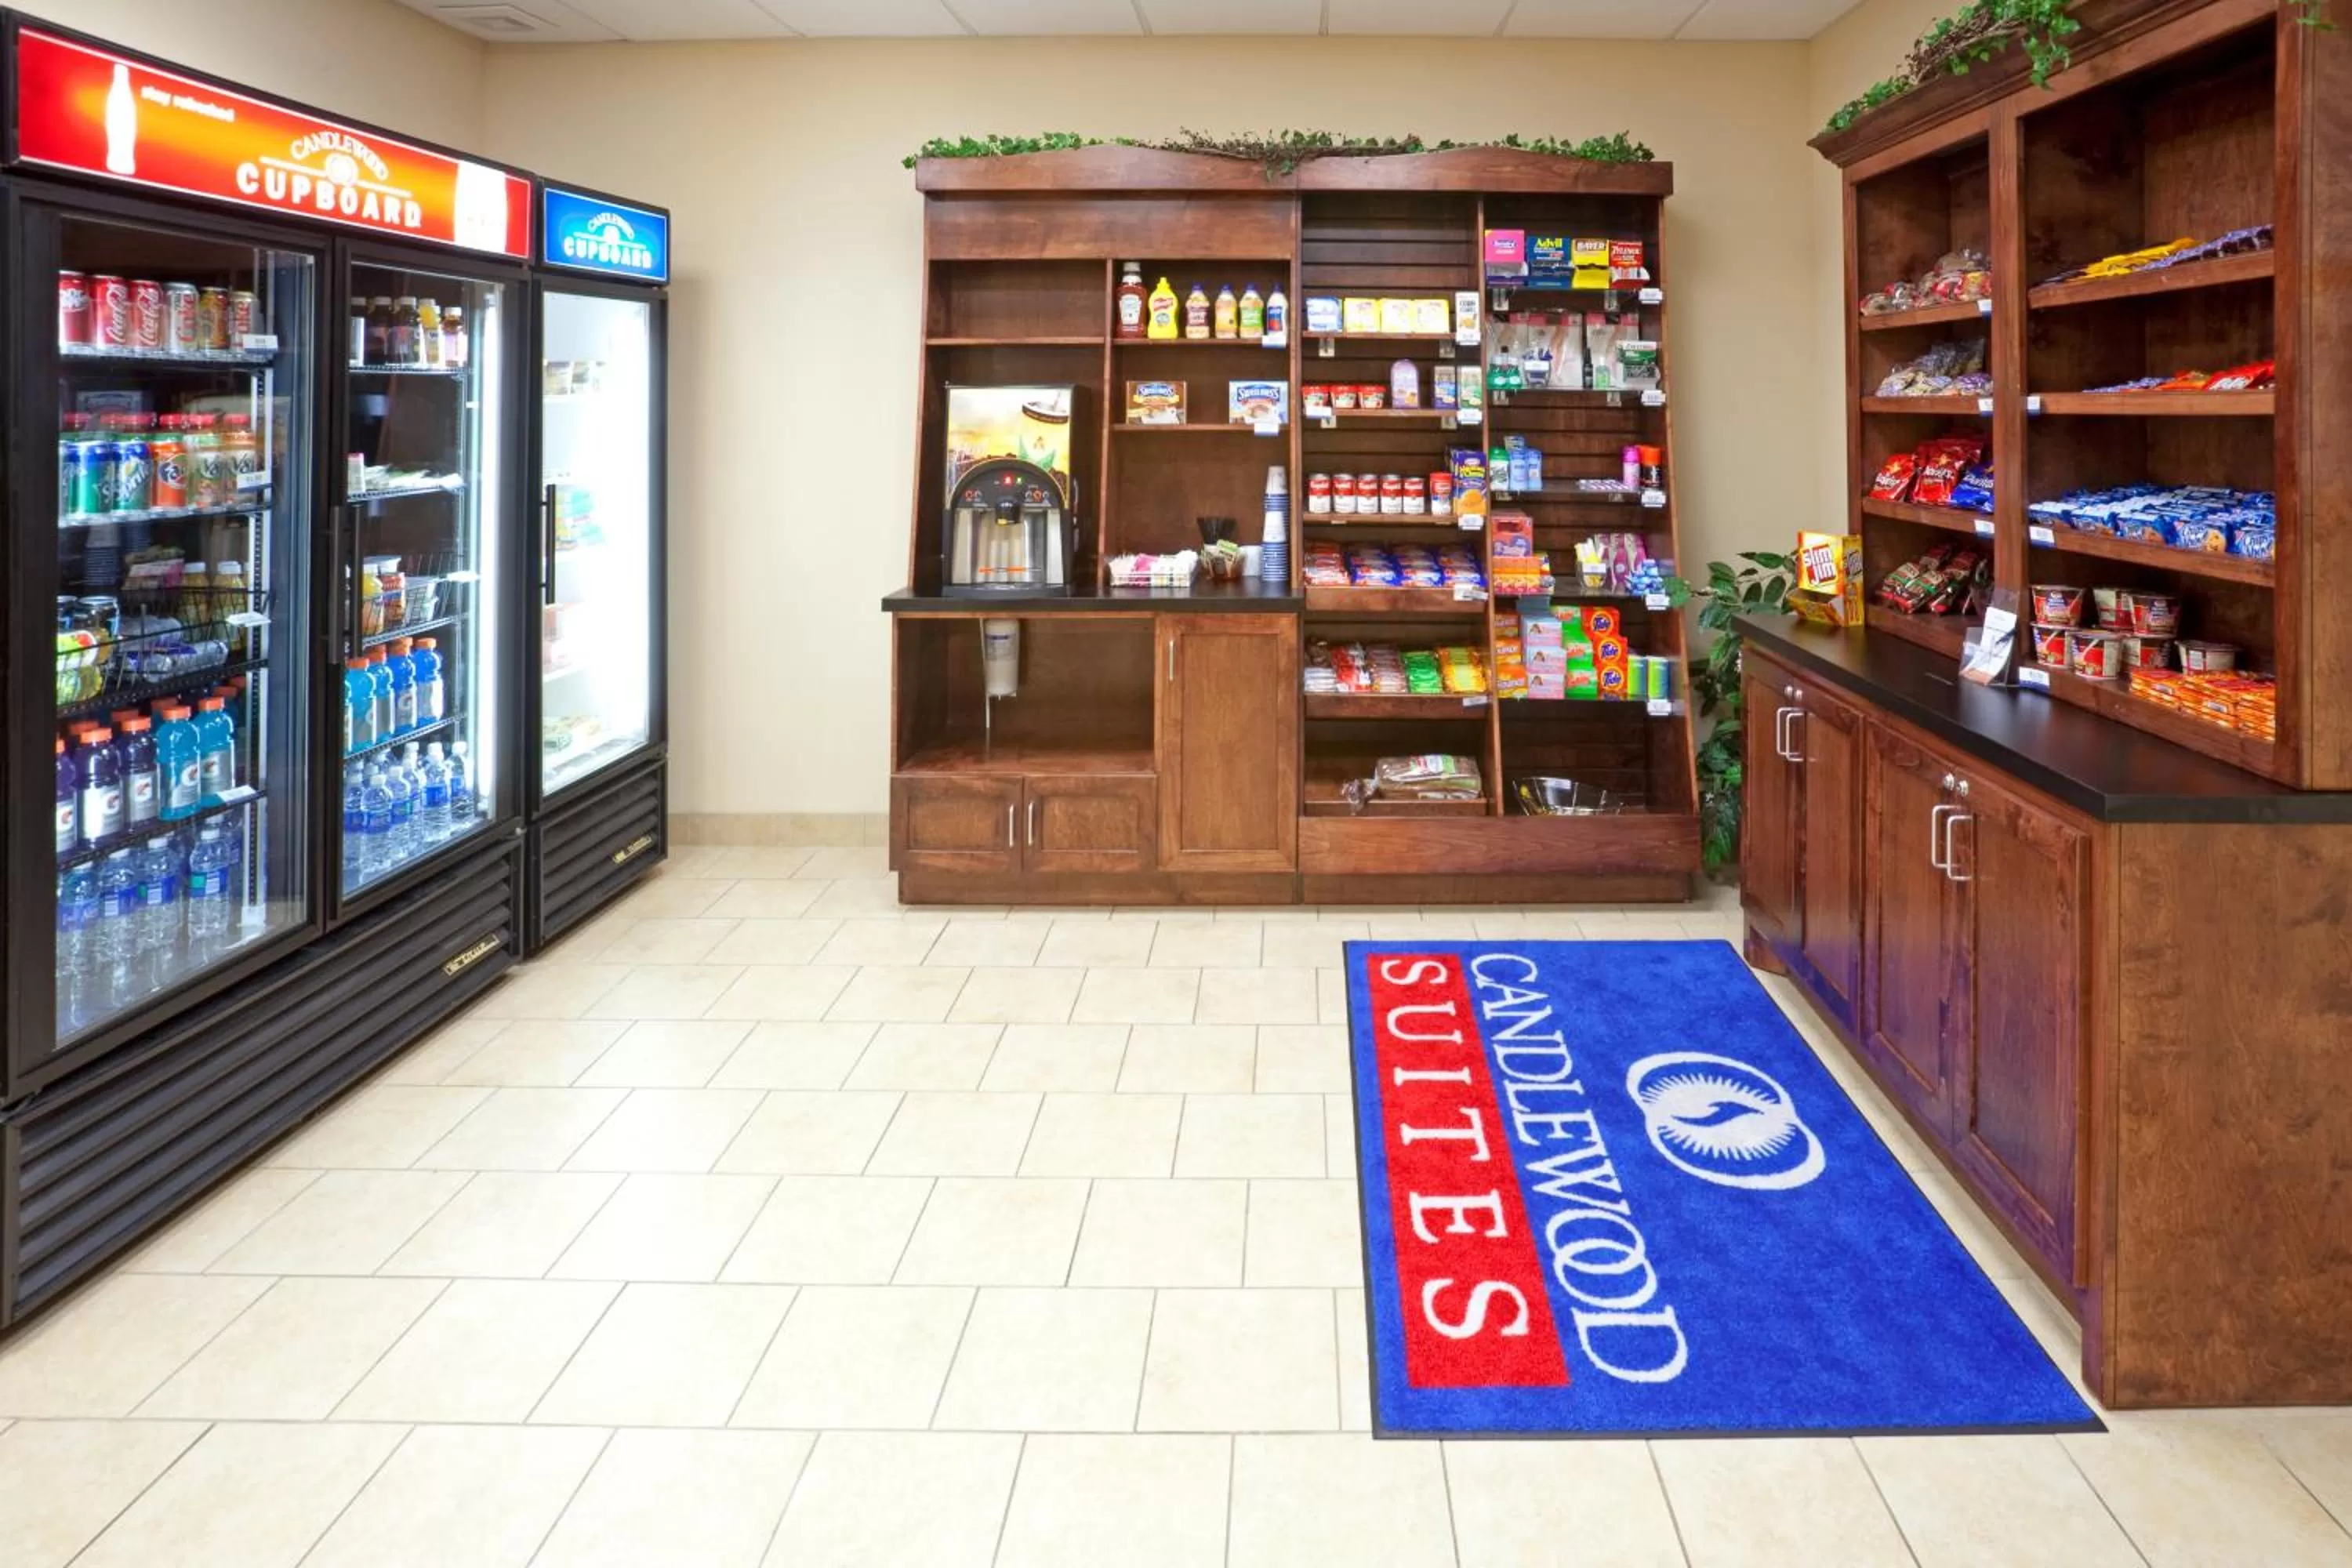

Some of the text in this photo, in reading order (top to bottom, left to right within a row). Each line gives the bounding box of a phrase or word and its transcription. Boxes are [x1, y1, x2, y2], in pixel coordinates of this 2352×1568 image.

[290, 131, 388, 181] CANDLEWOOD
[236, 162, 422, 227] CUPBOARD
[563, 236, 652, 269] CUPBOARD
[1534, 238, 1563, 249] Advil
[1381, 959, 1530, 1339] SUITES
[1471, 953, 1689, 1383] CANDLEWOOD
